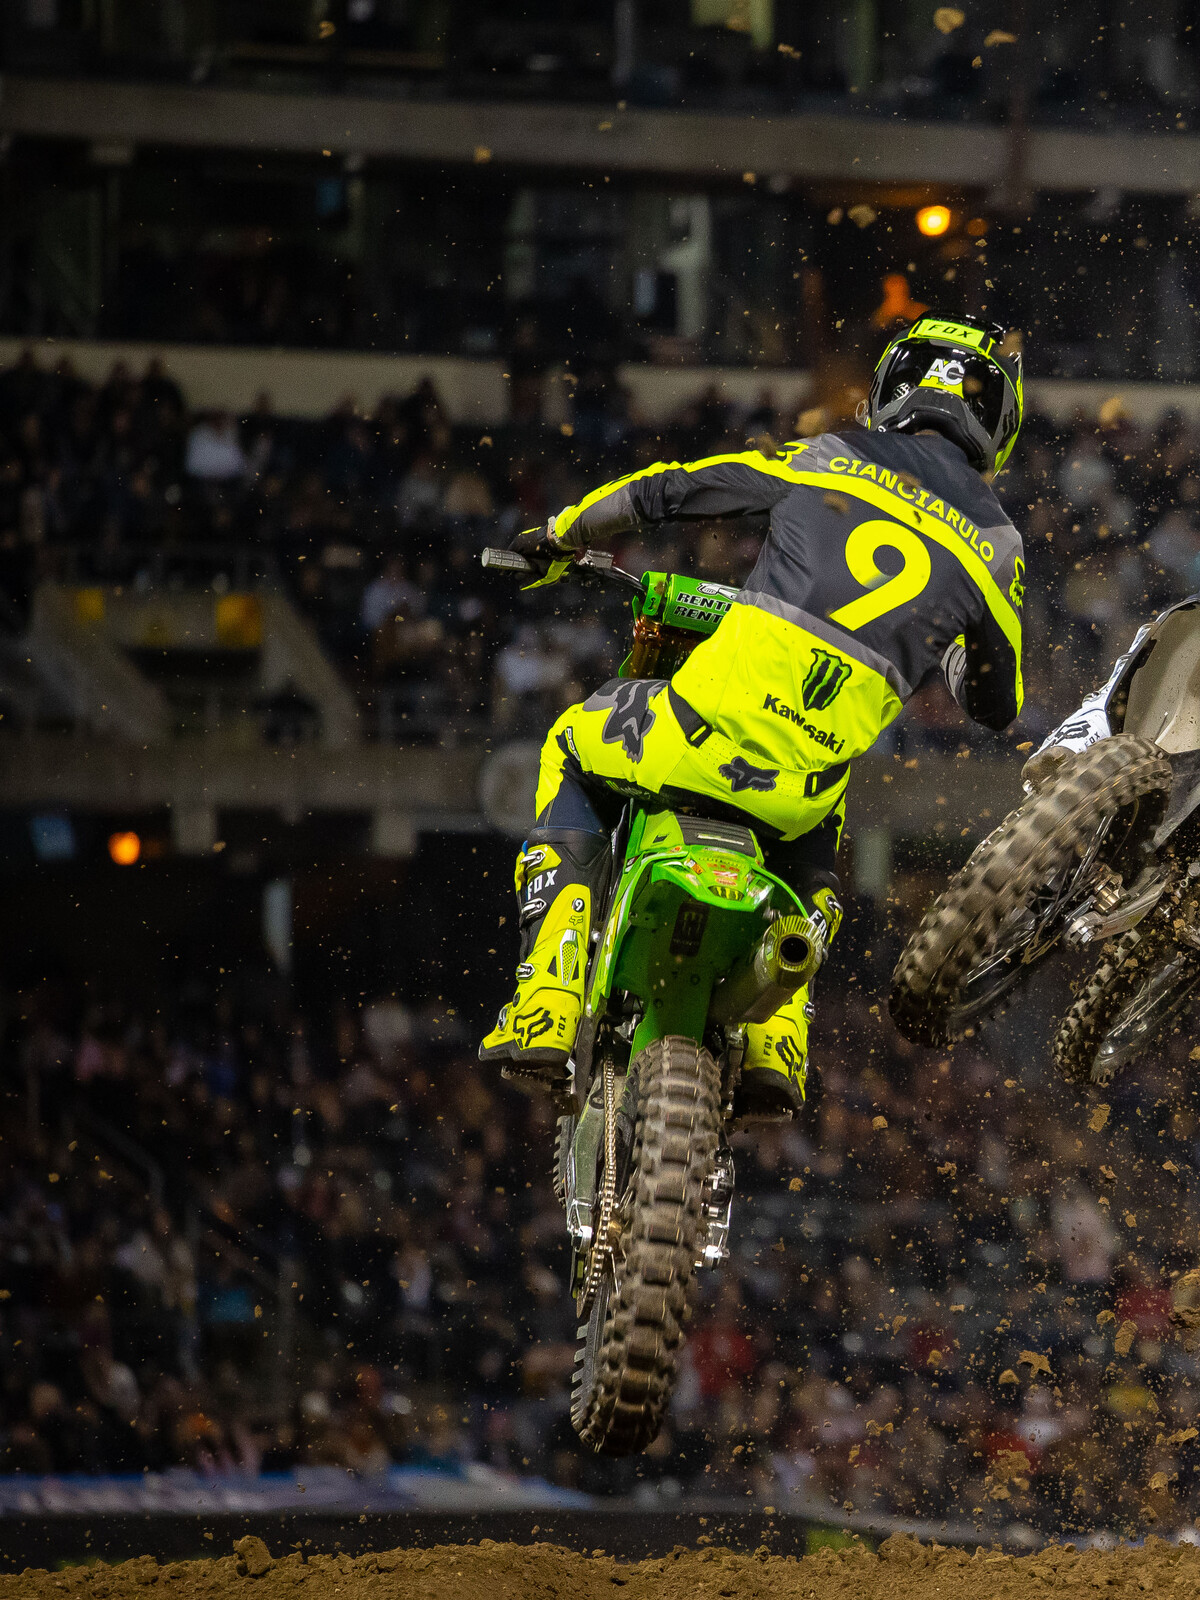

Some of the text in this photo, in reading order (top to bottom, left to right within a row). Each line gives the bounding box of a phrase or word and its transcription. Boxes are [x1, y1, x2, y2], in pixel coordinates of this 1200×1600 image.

[927, 324, 973, 339] FOX
[924, 358, 965, 386] AC
[829, 457, 995, 562] CIANCIARULO
[829, 520, 931, 631] 9
[528, 870, 558, 900] FOX
[574, 899, 583, 911] 9
[557, 1014, 567, 1038] FOX
[763, 1034, 773, 1056] FOX
